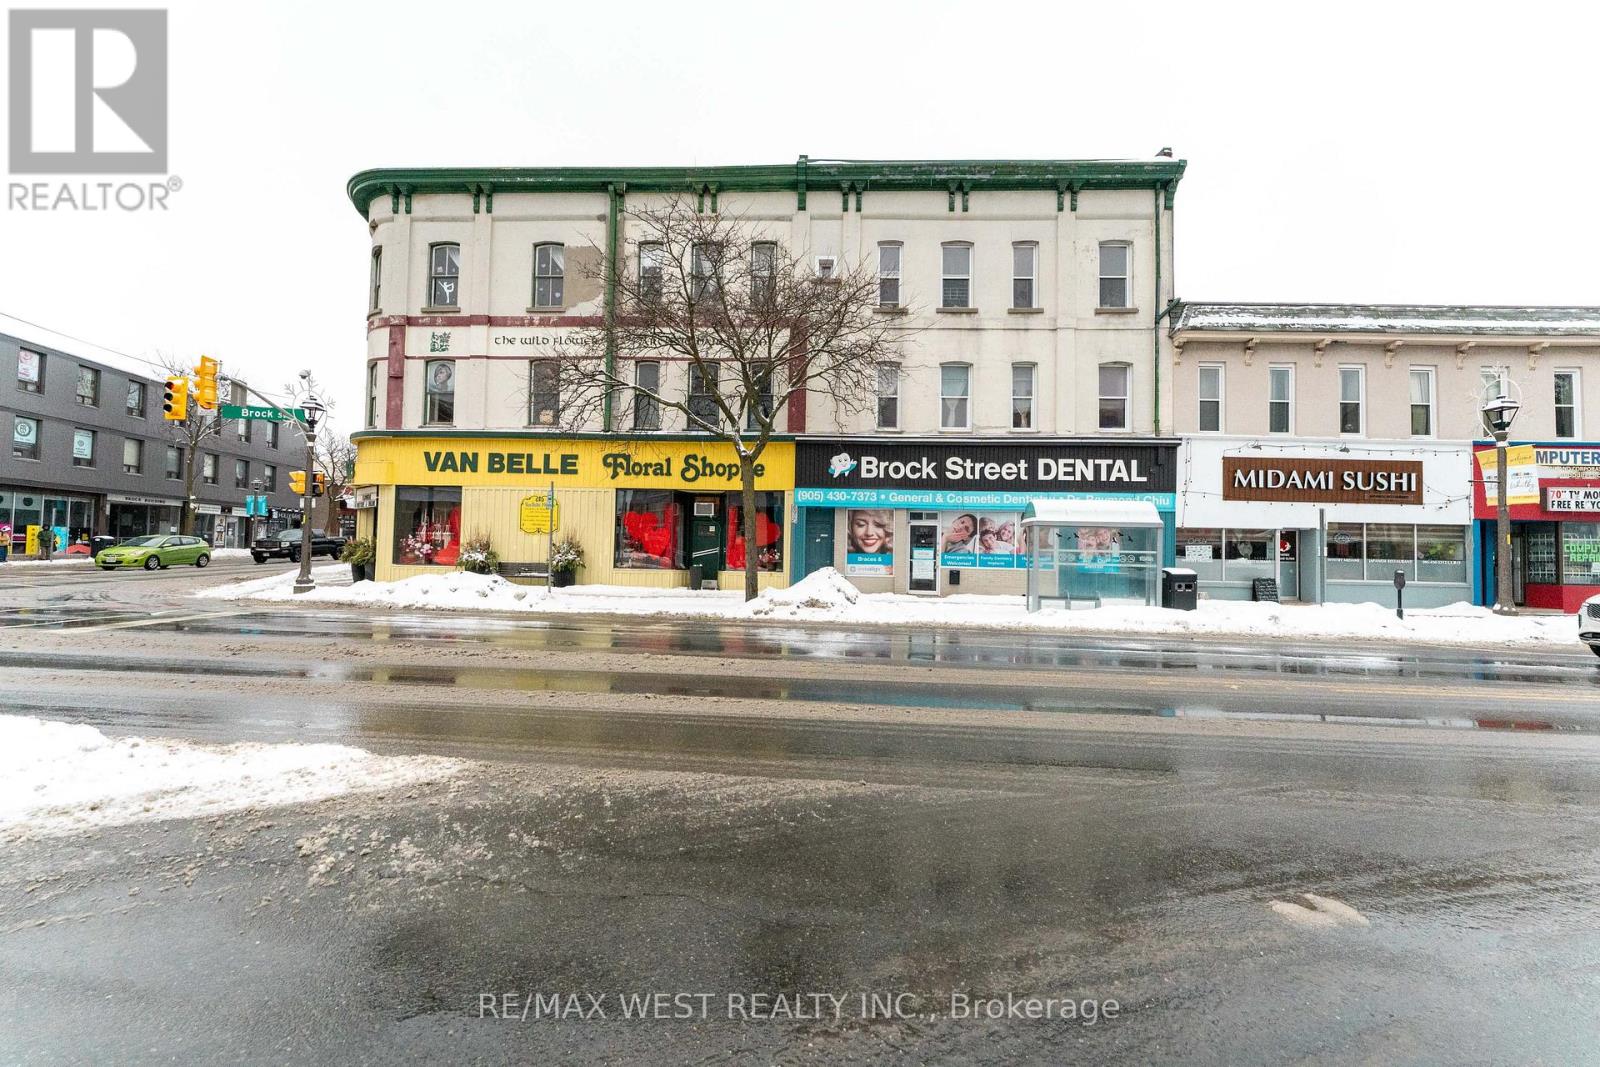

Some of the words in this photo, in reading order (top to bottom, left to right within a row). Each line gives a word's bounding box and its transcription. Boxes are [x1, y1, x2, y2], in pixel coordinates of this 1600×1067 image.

[241, 408, 273, 418] Brock
[423, 451, 478, 473] VAN
[487, 452, 579, 475] BELLE
[602, 452, 672, 480] Floral
[680, 454, 766, 482] Shope
[860, 456, 938, 480] Brock
[945, 456, 1028, 481] Street
[1038, 458, 1147, 482] DENTAL
[1233, 469, 1334, 490] MIDAMI
[1343, 471, 1417, 492] SUSHI
[797, 490, 824, 503] (905)
[826, 491, 878, 502] 430-7373
[888, 492, 932, 503] General
[935, 494, 944, 503] &
[946, 493, 1000, 505] Cosmetic
[1551, 500, 1571, 509] FREE
